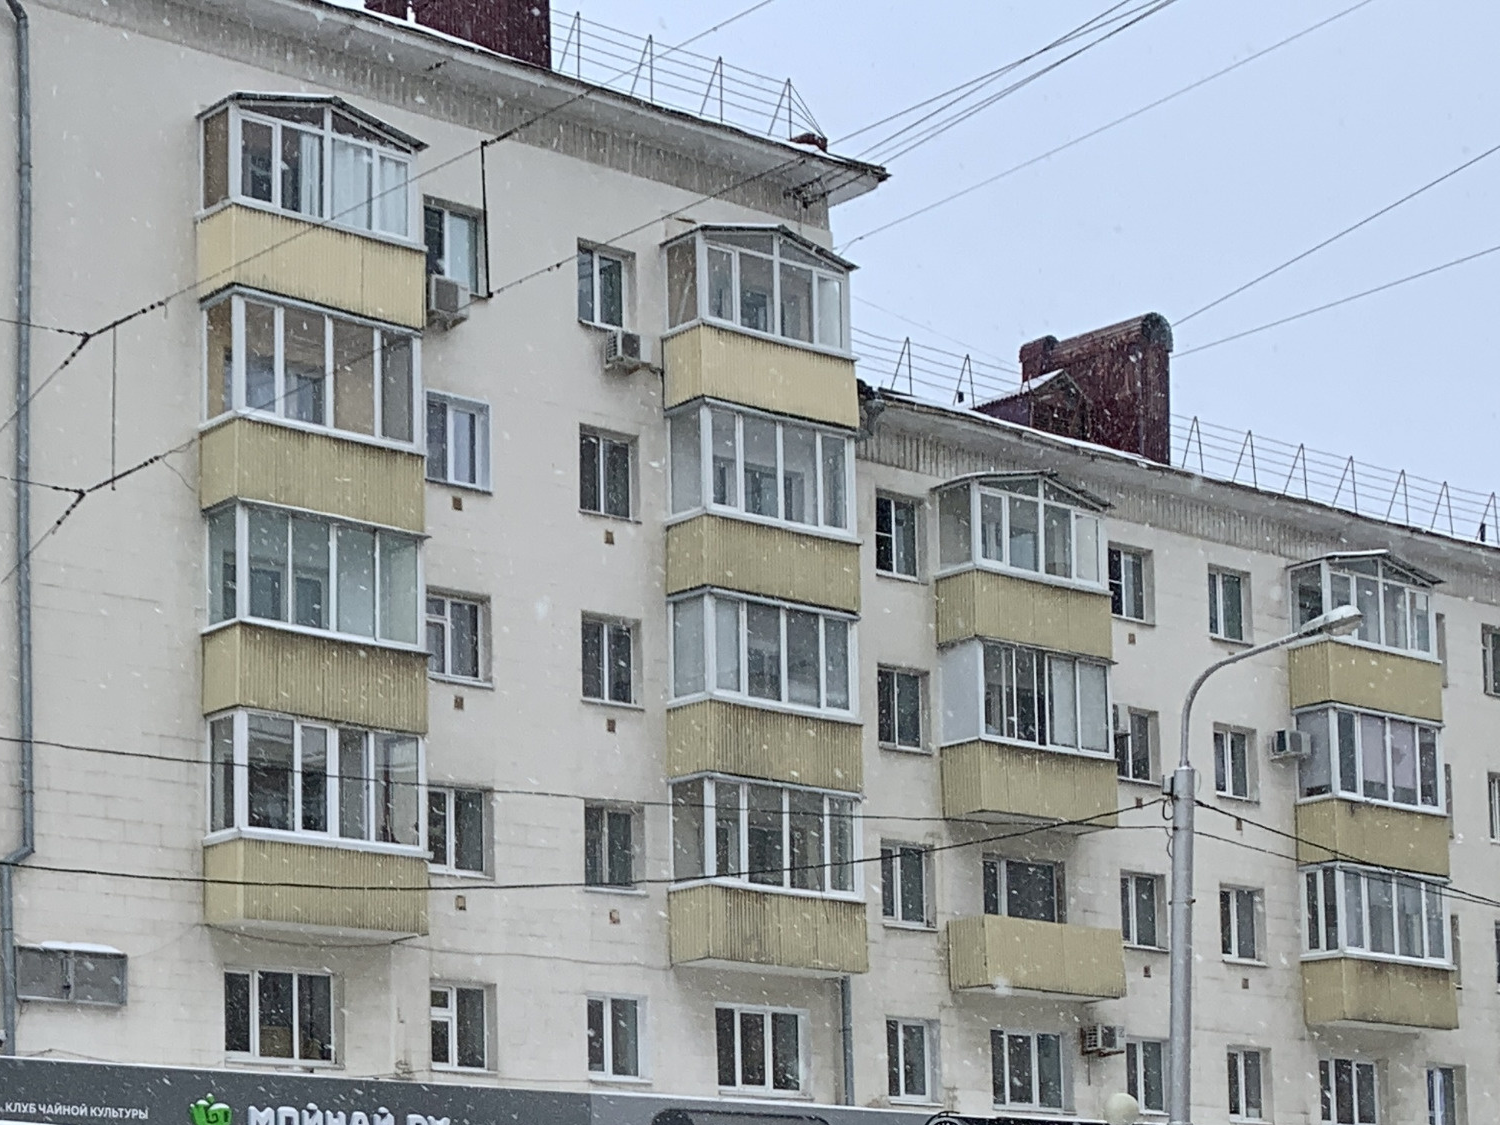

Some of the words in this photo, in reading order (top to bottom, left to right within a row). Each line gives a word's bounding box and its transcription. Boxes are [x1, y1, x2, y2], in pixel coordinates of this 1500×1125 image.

[5, 1102, 36, 1113] КЛУБ
[38, 1102, 88, 1116] ЧАЙНОЙ
[90, 1106, 149, 1119] КУЛЬТУРЫ
